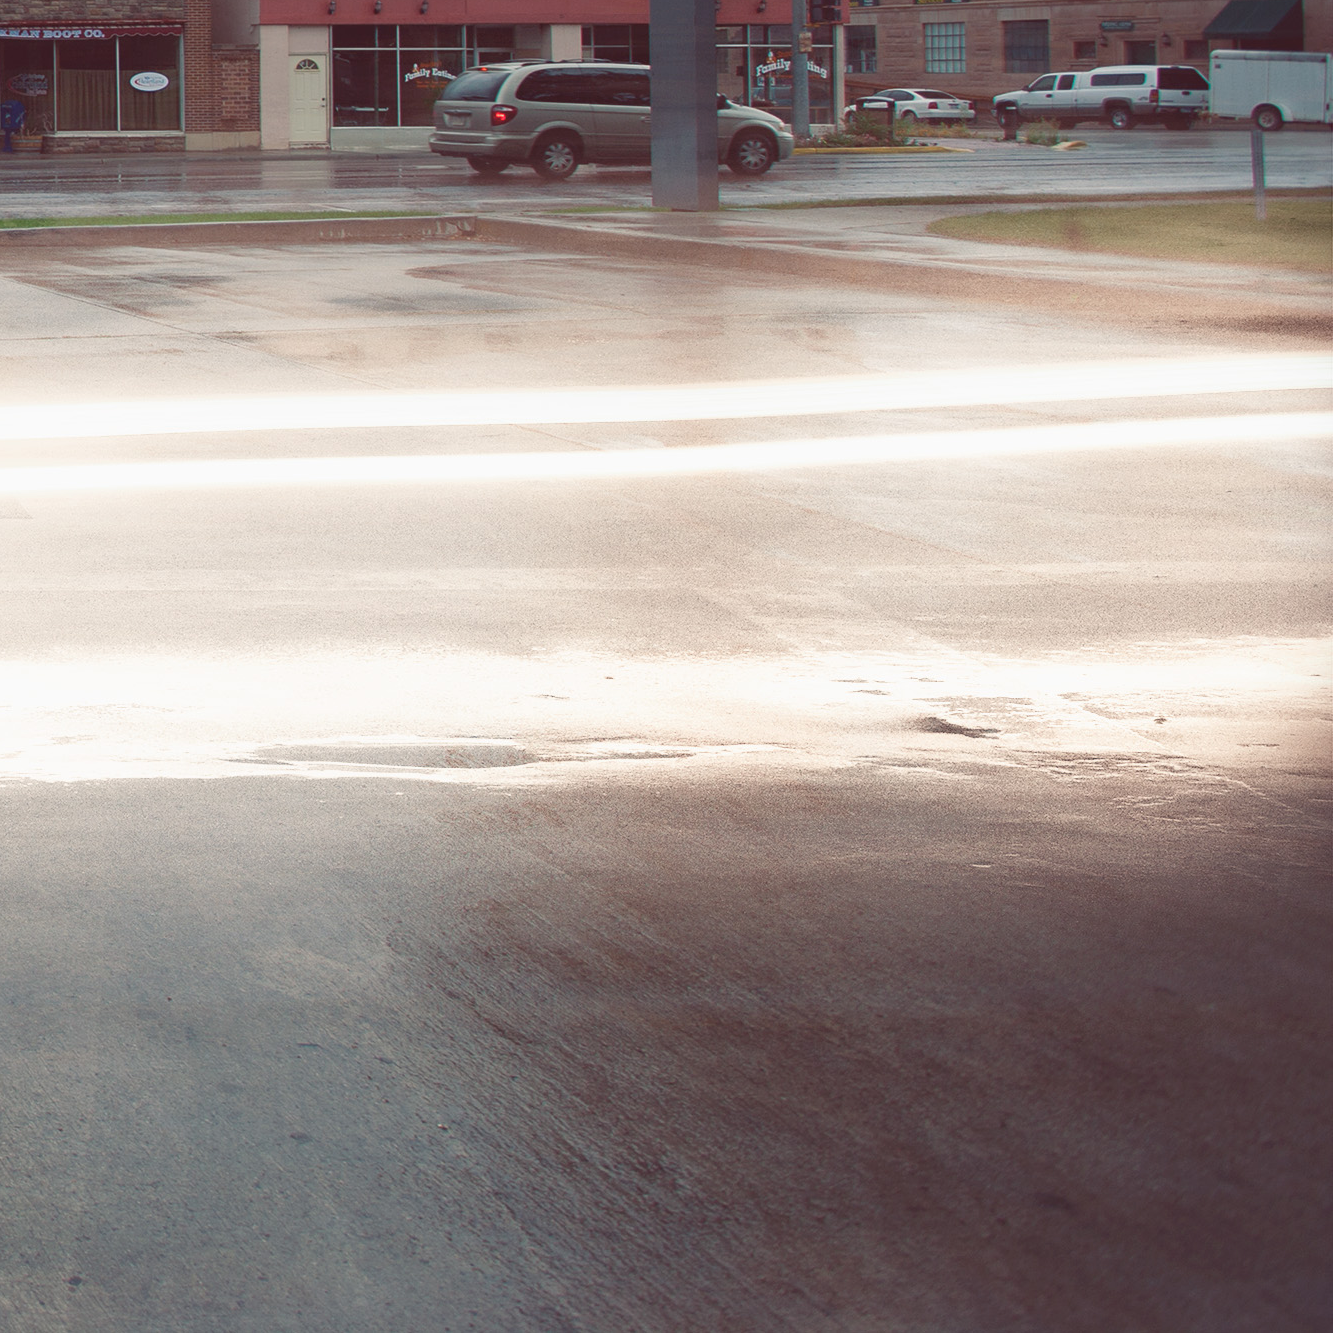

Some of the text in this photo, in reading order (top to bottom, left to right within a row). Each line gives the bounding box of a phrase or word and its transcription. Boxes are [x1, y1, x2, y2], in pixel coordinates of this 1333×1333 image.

[43, 29, 81, 39] BOOT
[83, 29, 105, 38] CO.
[755, 58, 828, 79] Family ting
